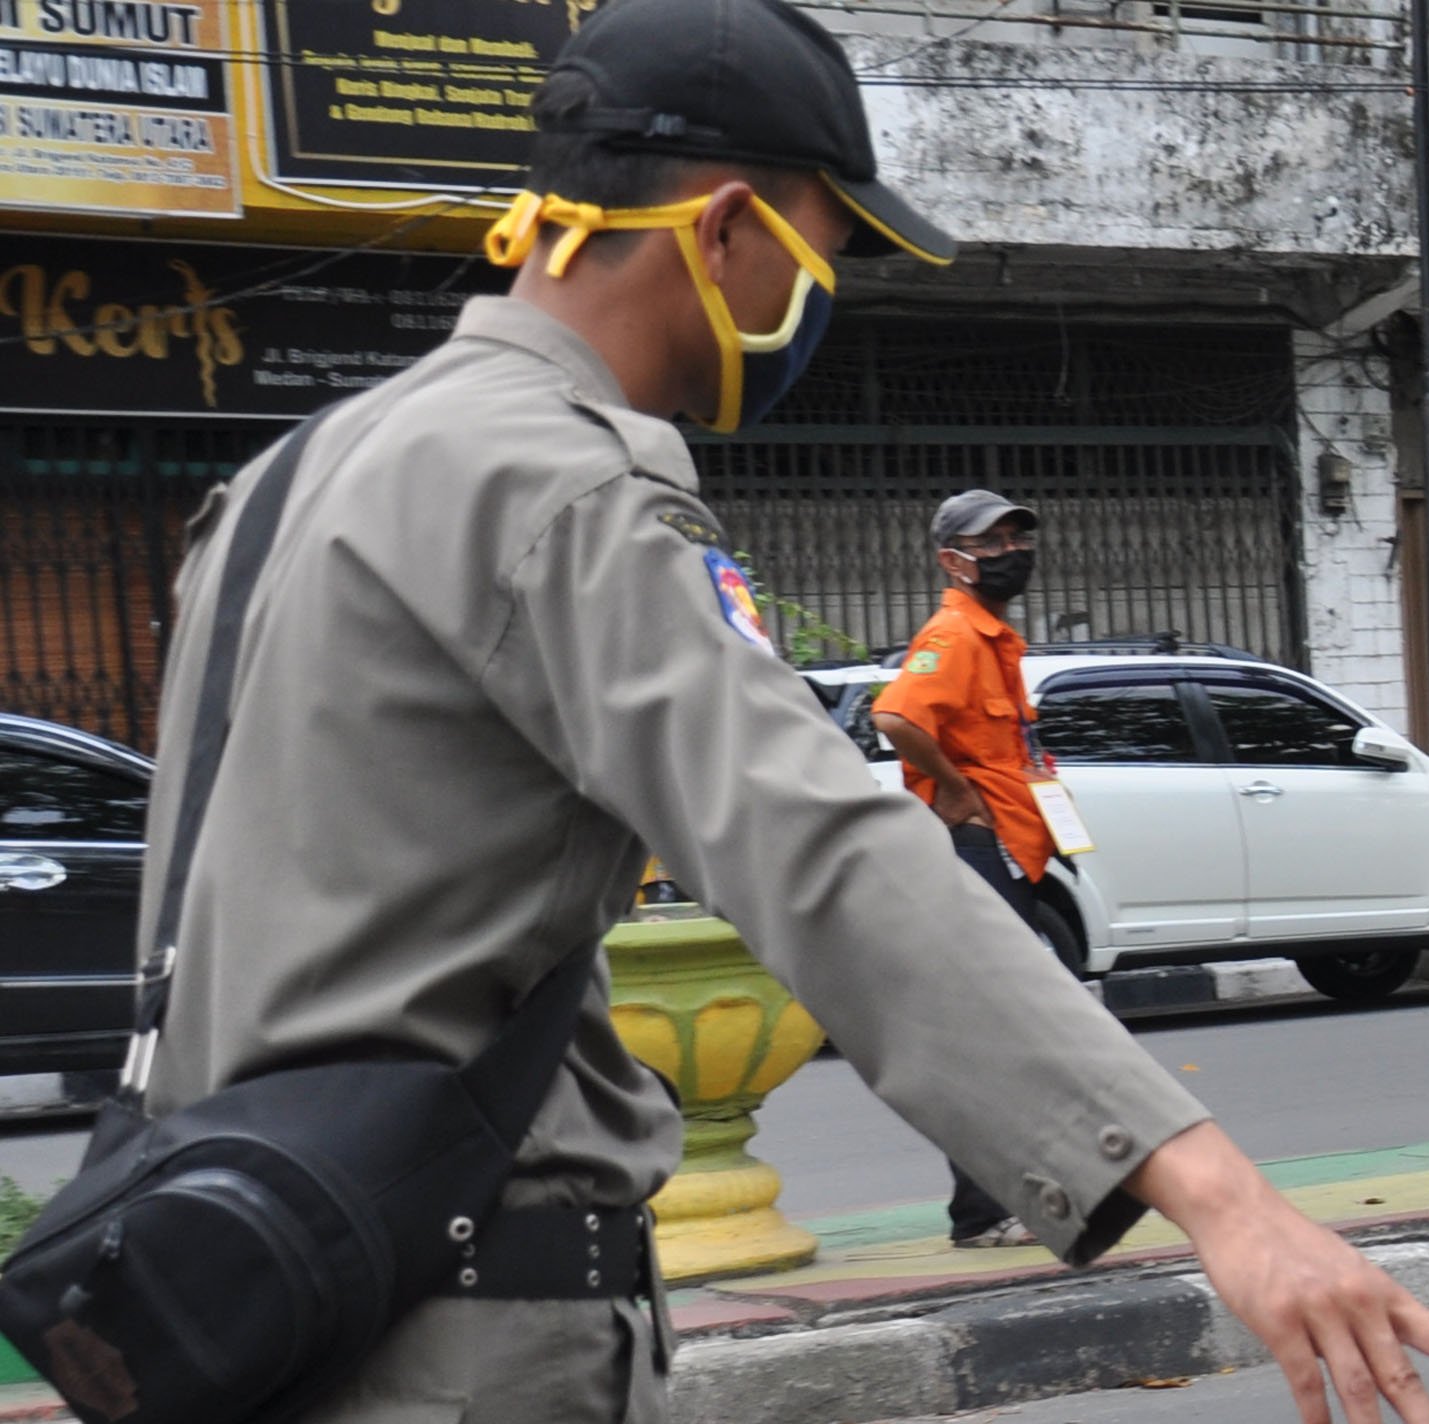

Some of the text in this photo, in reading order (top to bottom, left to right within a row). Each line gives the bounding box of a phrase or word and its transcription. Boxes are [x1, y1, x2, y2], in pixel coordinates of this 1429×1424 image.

[41, 0, 199, 44] SUMUT
[18, 106, 138, 147] SUMATERA
[141, 114, 215, 153] UTARA
